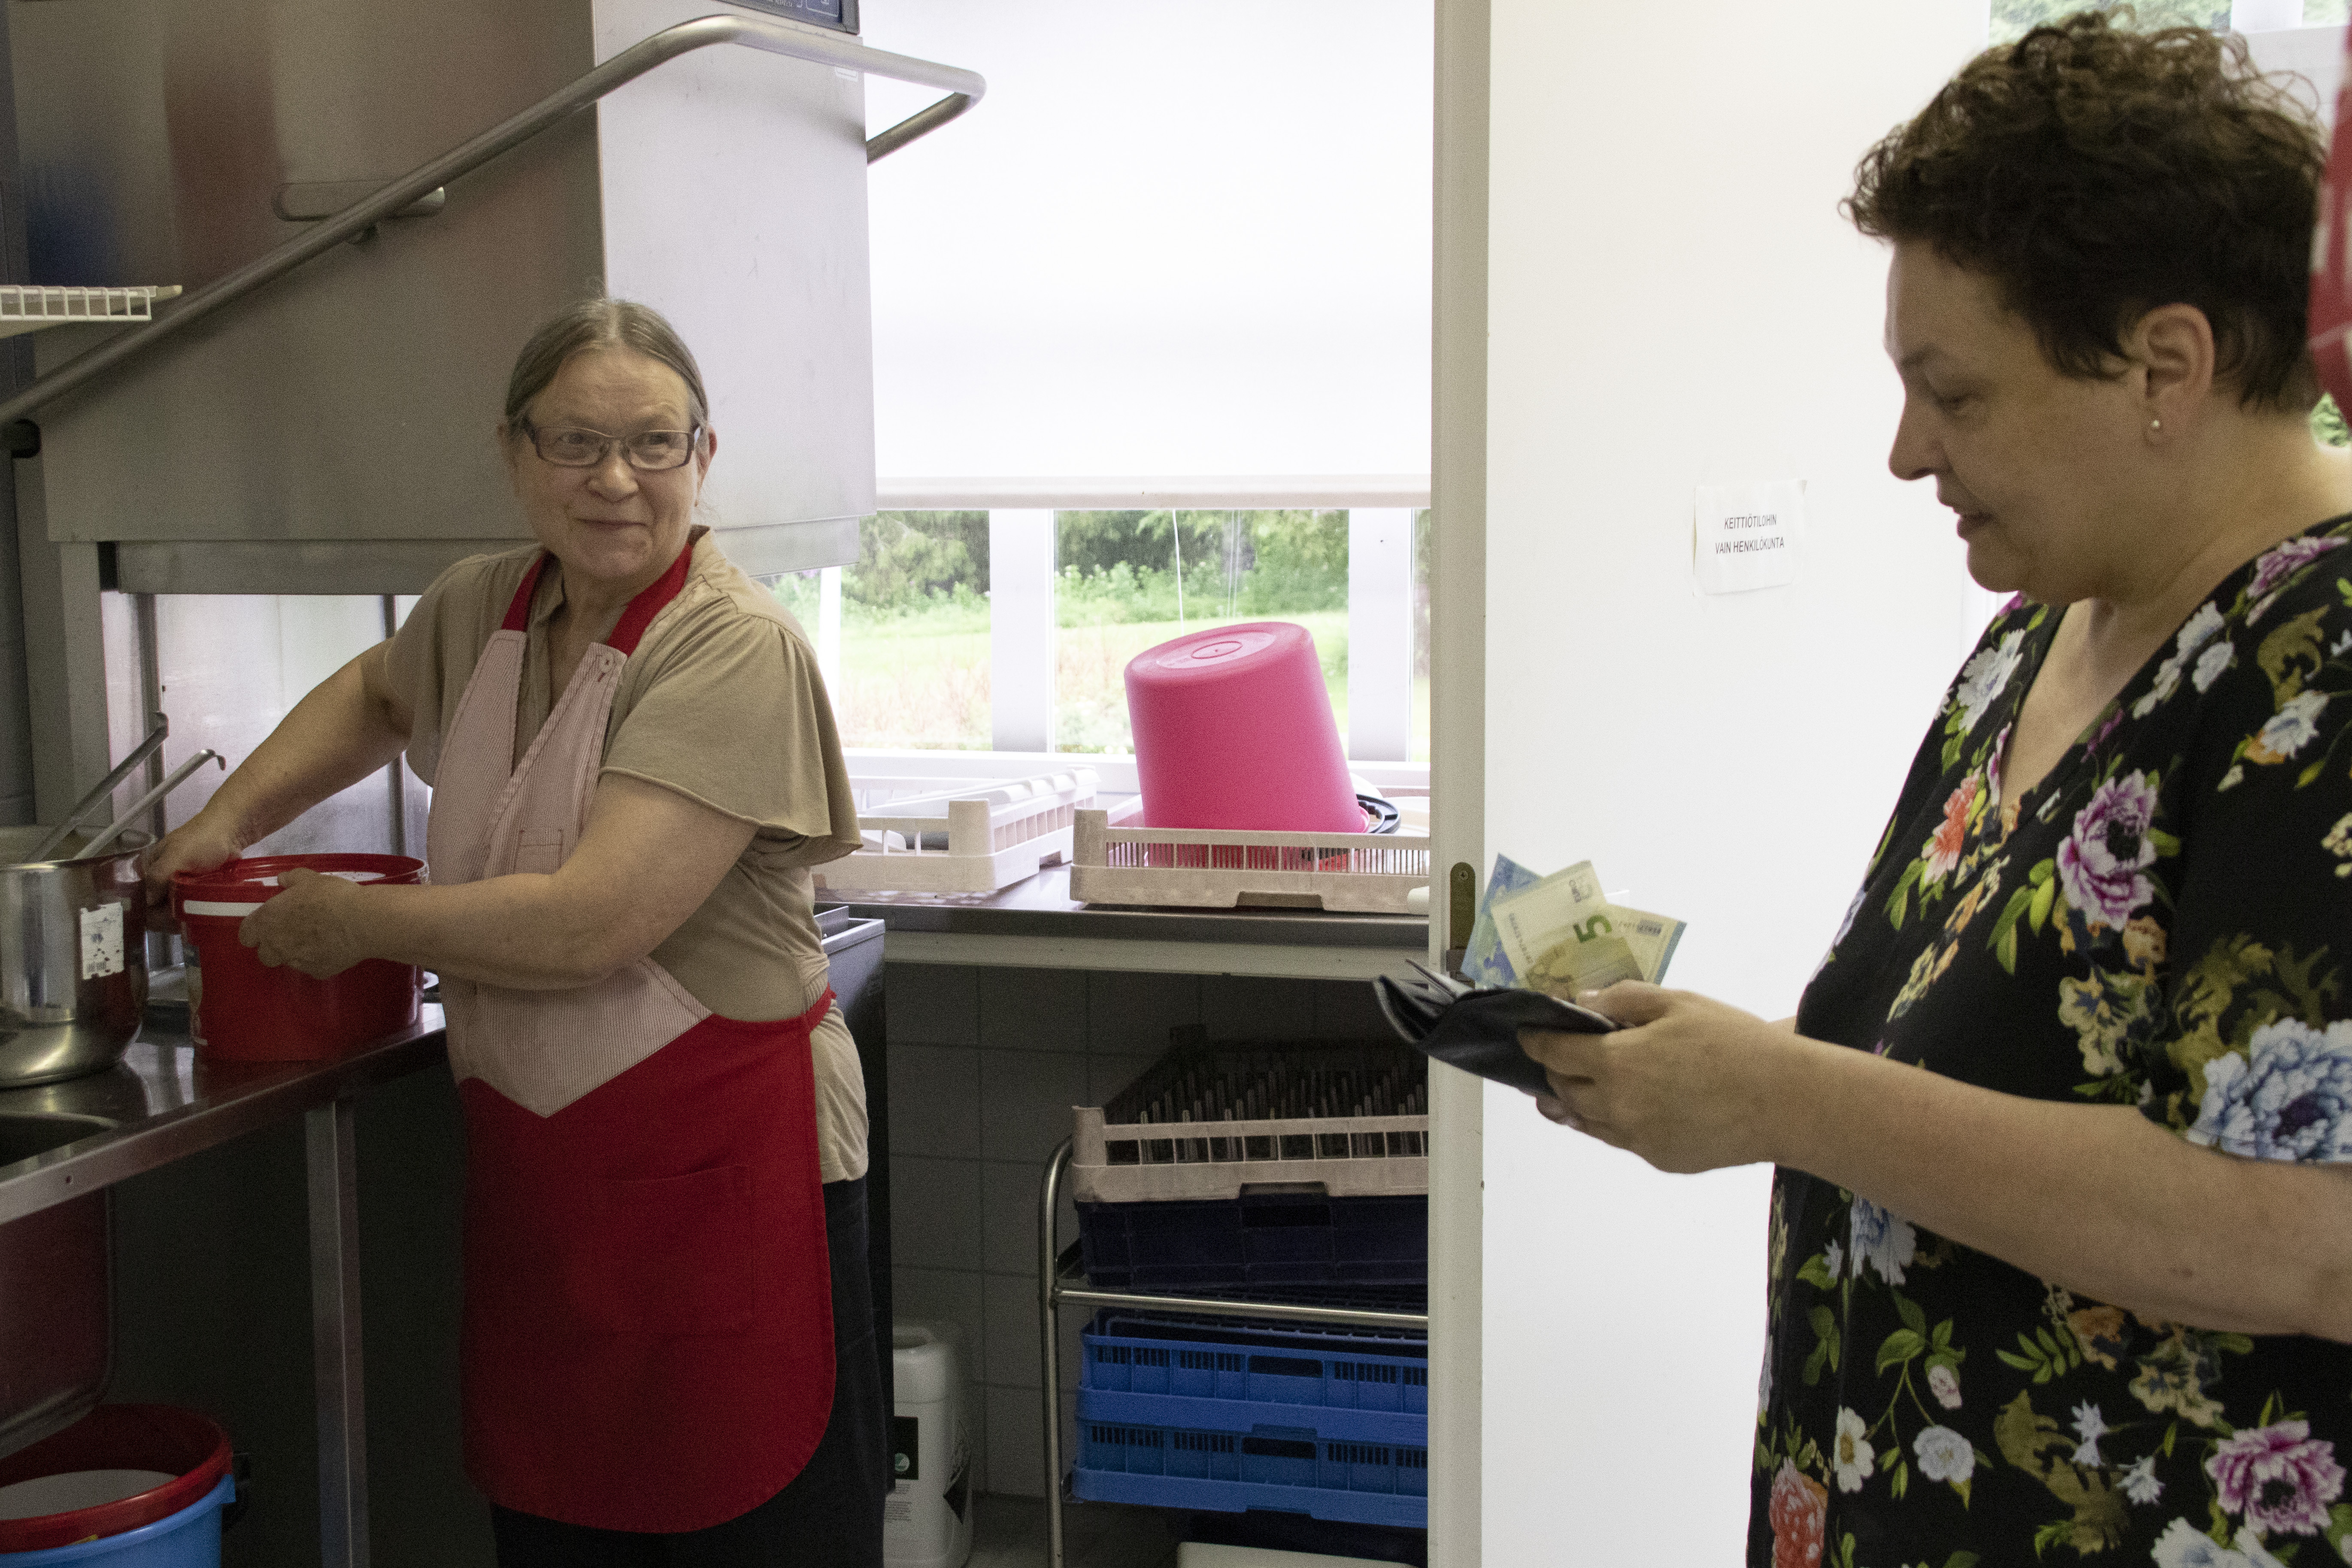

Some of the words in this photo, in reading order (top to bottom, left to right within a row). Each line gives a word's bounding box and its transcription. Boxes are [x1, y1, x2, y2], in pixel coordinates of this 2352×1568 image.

[1724, 513, 1776, 529] KEITTIÖTILOIHIN
[1716, 541, 1731, 554] VAIN
[1734, 536, 1784, 552] HENKILÖKUNTA
[1573, 915, 1612, 943] 5
